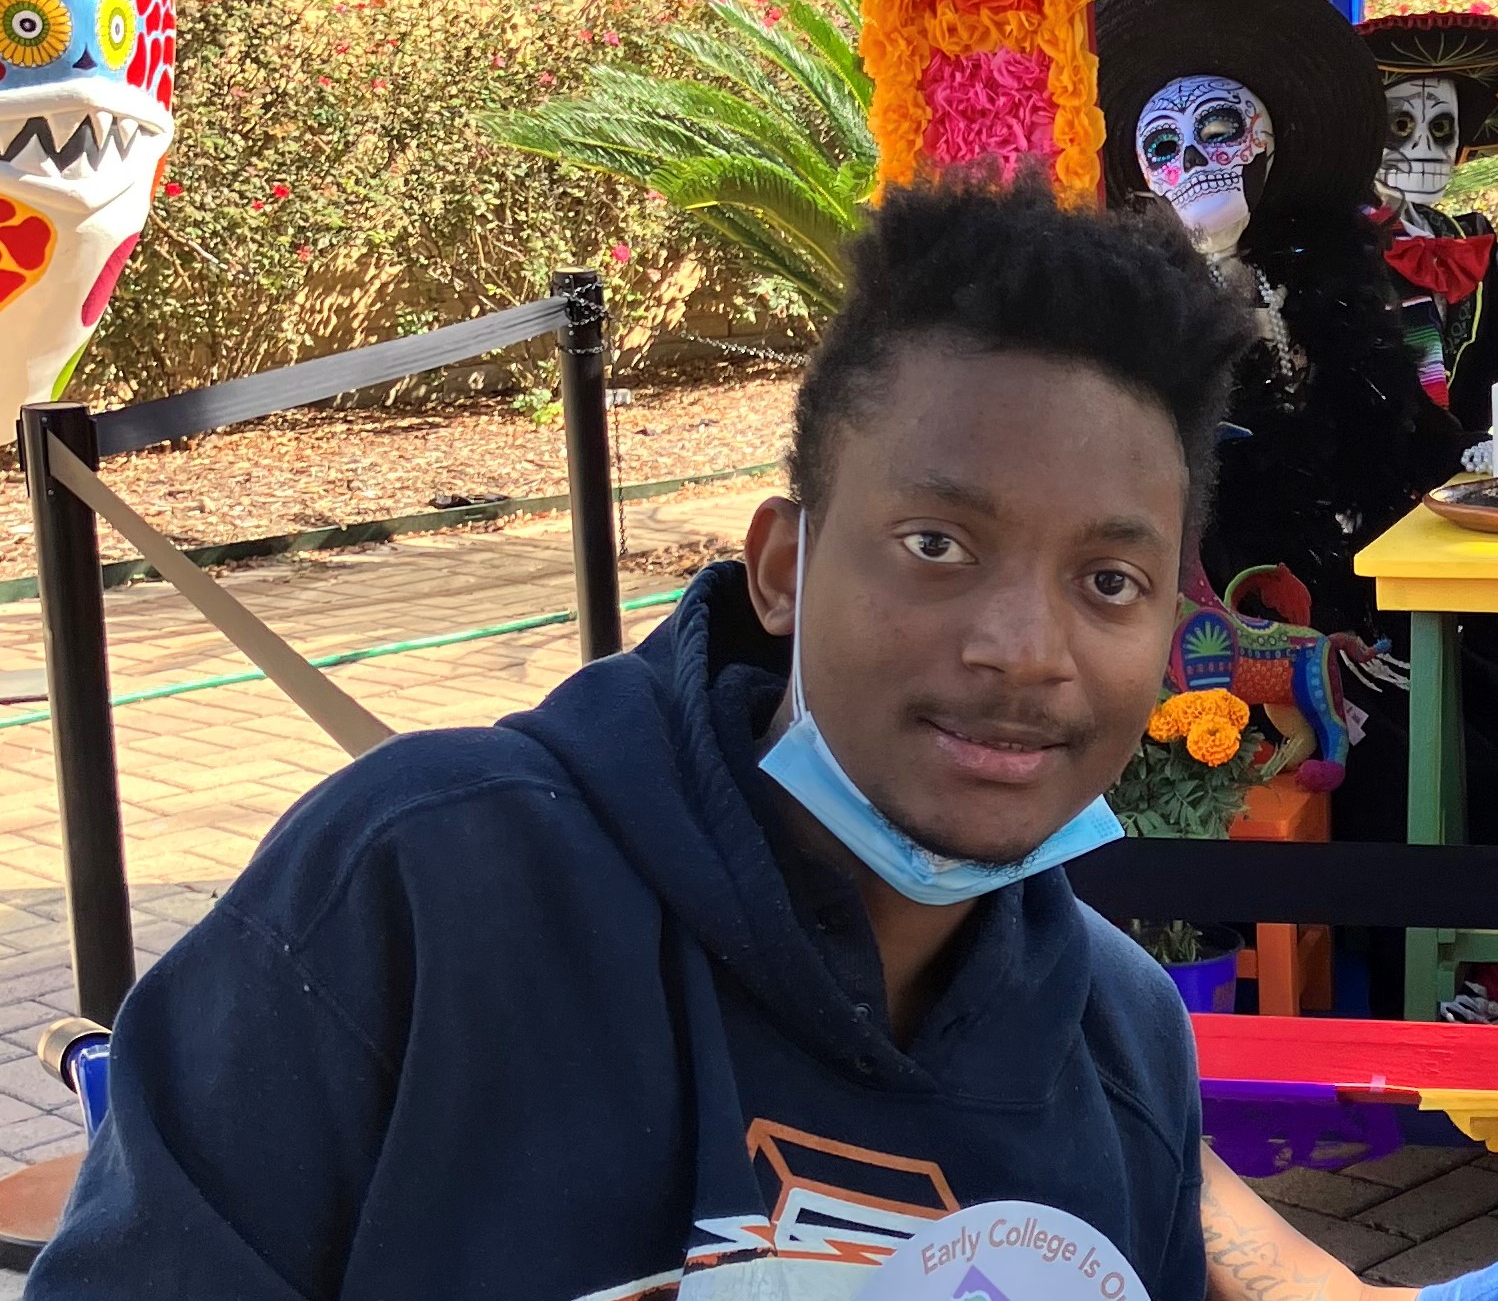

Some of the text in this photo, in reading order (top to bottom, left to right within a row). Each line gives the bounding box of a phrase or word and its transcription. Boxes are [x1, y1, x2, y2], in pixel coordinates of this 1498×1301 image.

[921, 1225, 981, 1276] Early
[989, 1217, 1078, 1263] College
[1077, 1246, 1102, 1279] Is
